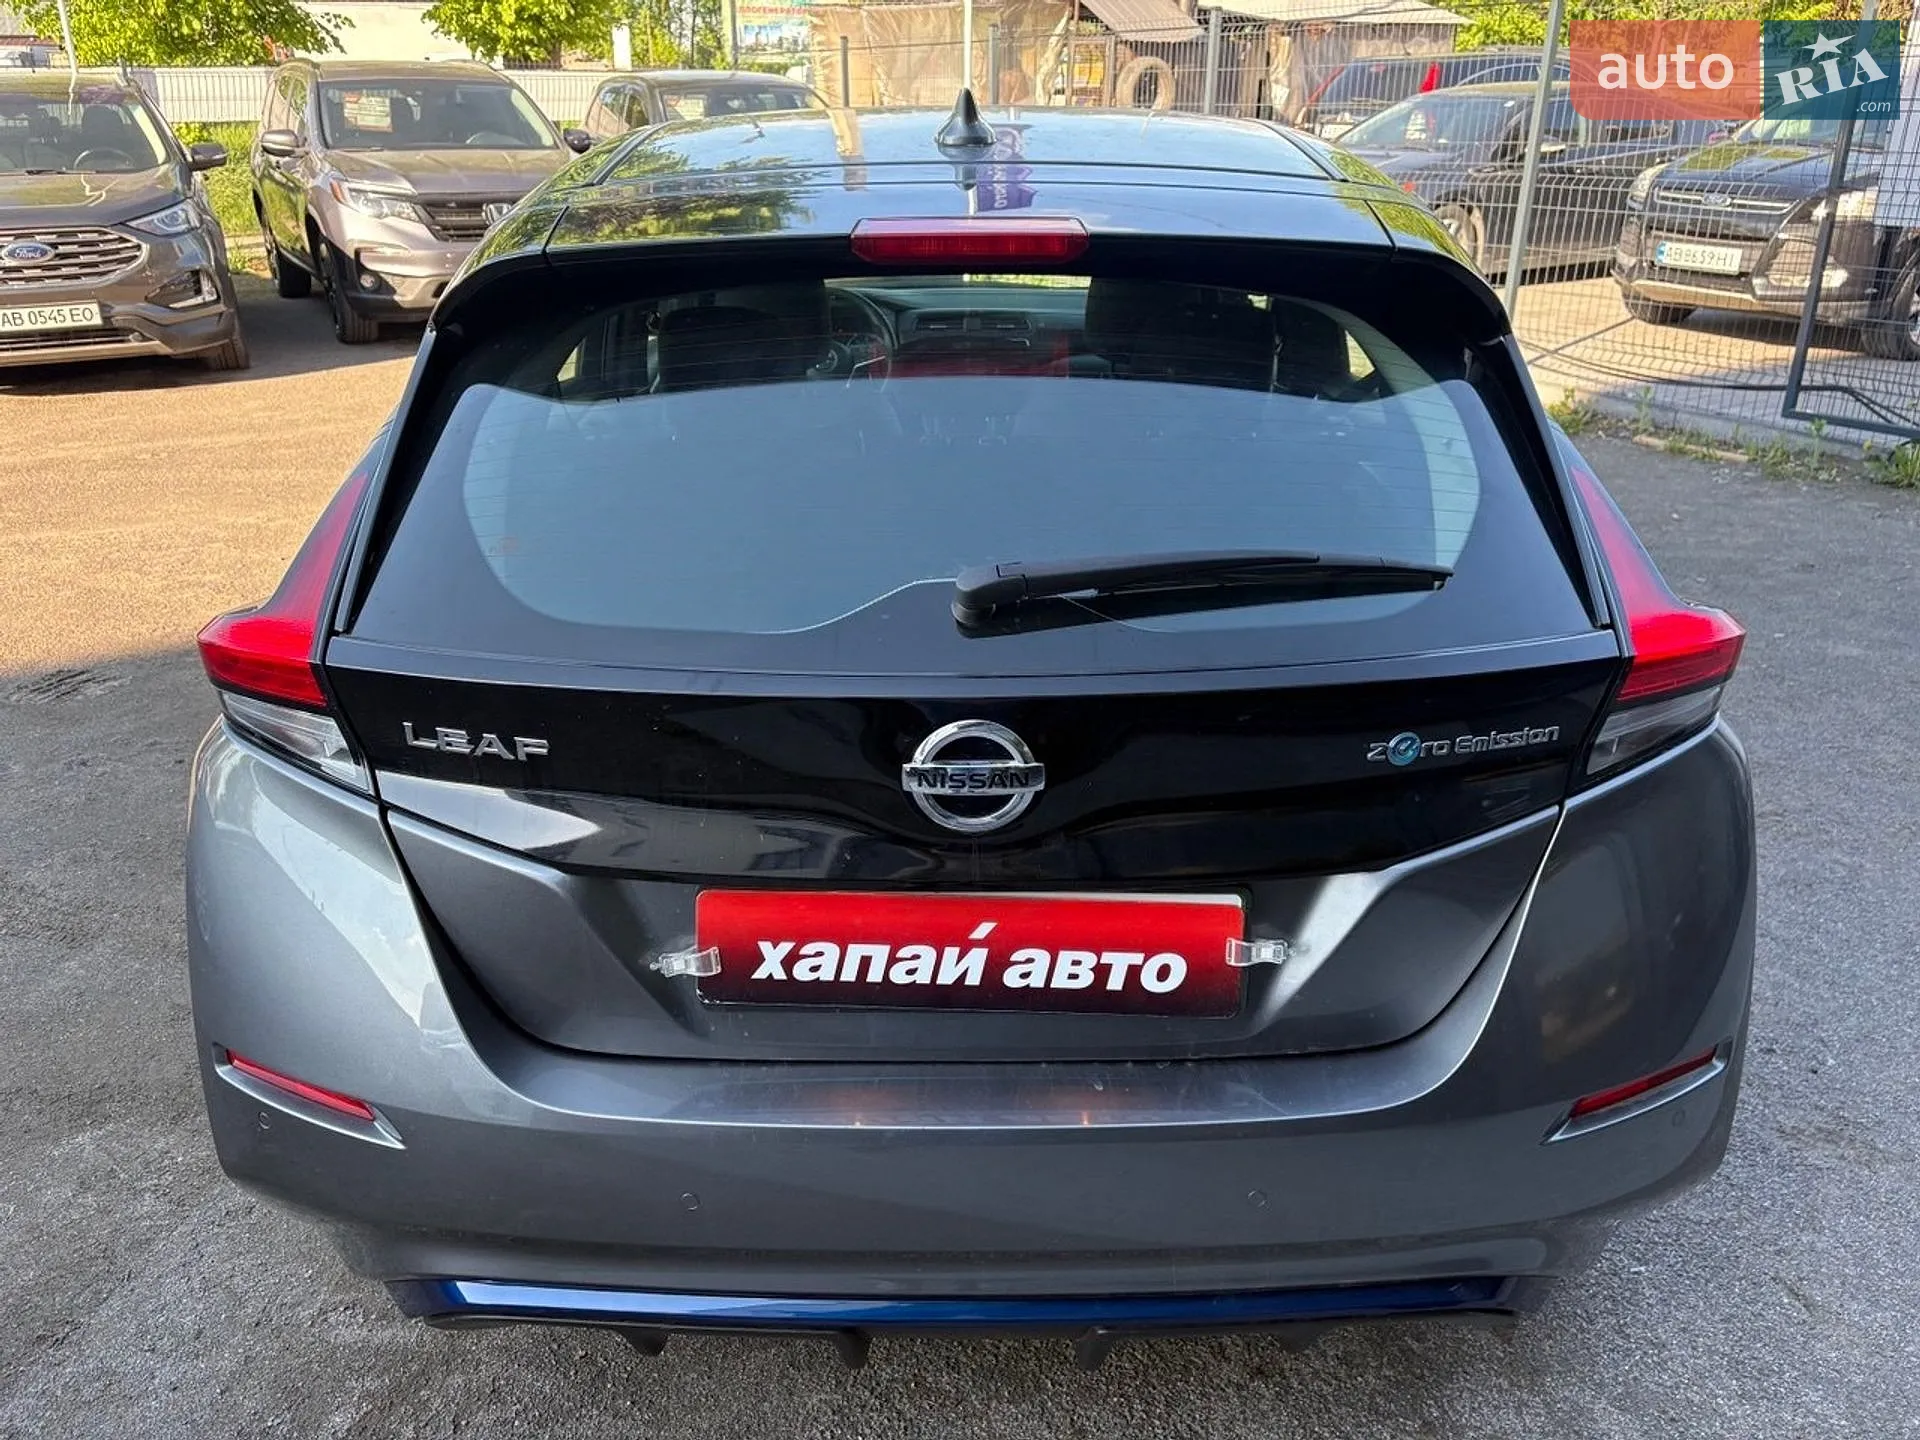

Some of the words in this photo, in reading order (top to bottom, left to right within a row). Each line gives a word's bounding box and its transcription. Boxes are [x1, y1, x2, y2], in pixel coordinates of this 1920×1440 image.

[28, 308, 67, 326] 0545
[402, 721, 550, 761] LEAF
[1454, 725, 1560, 755] Emission
[917, 771, 1030, 789] NISSAN
[1002, 947, 1188, 993] авто
